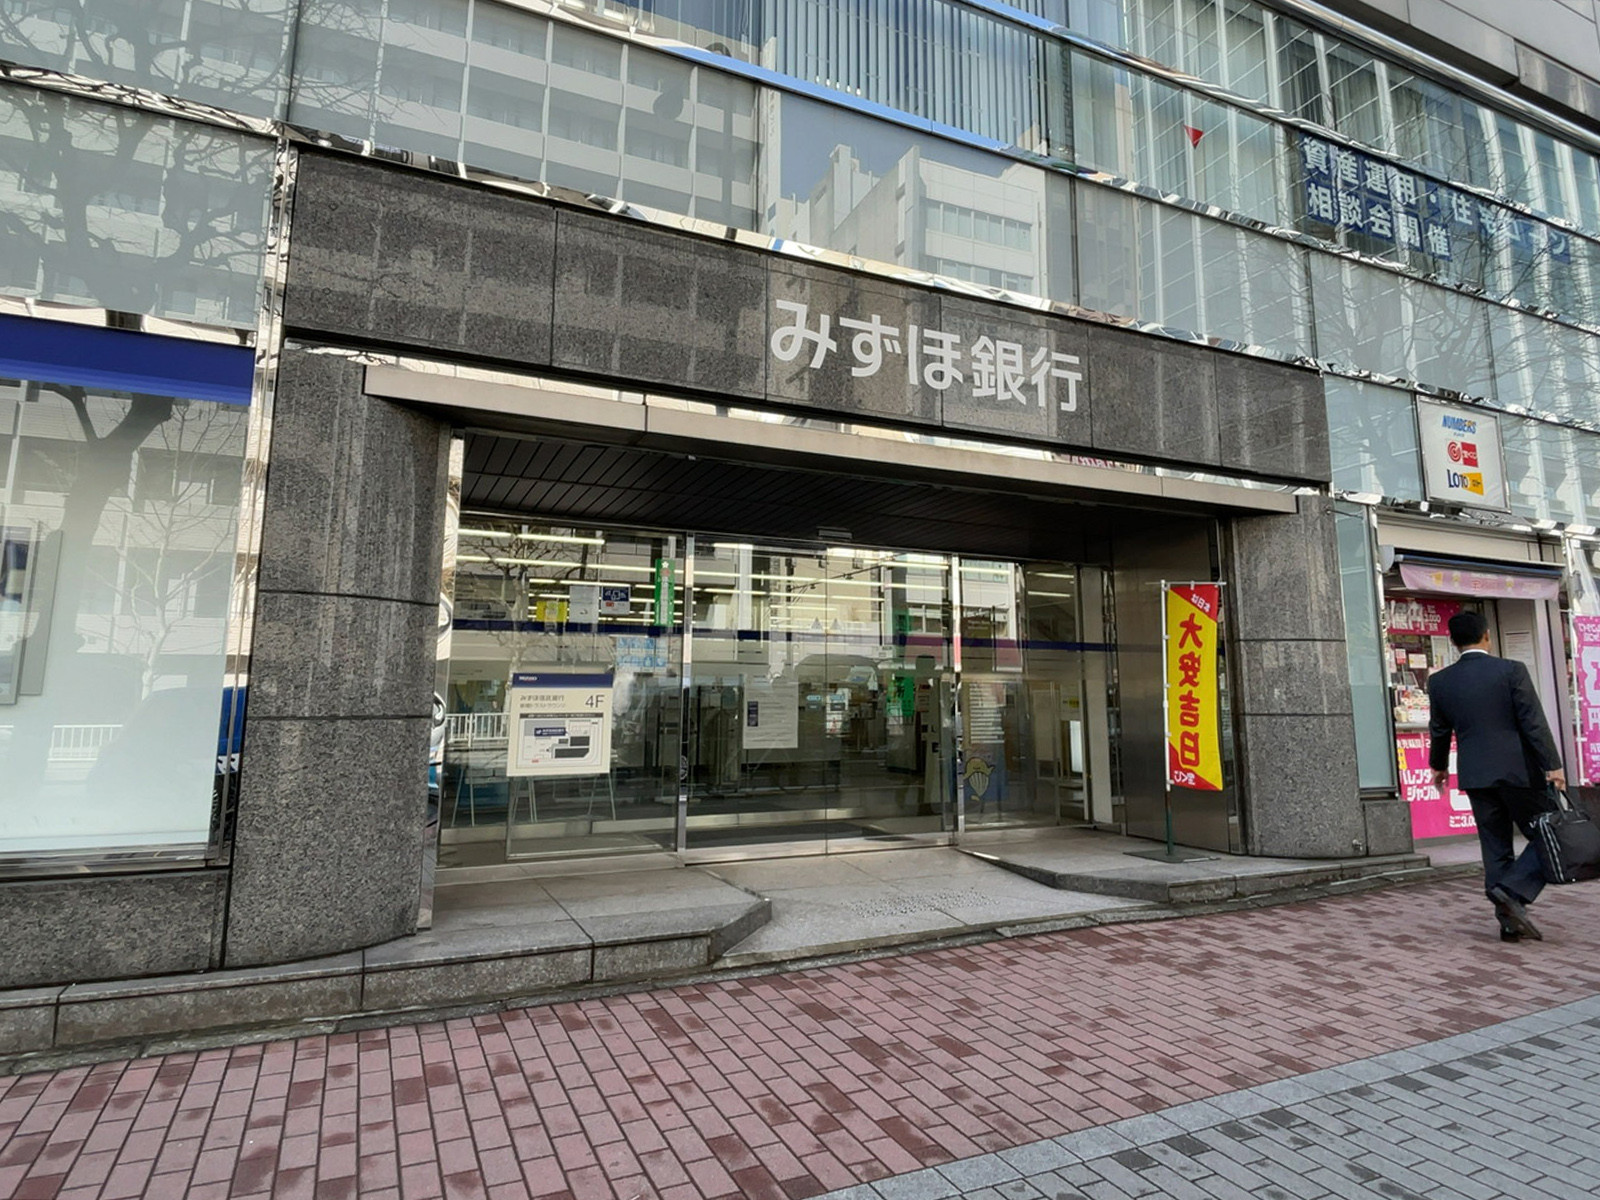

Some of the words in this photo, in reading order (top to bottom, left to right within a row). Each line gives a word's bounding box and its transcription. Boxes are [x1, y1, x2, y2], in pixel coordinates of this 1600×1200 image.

[1308, 183, 1450, 257] 相談会開催
[770, 299, 1082, 412] みずほ銀行
[585, 694, 605, 709] 4F
